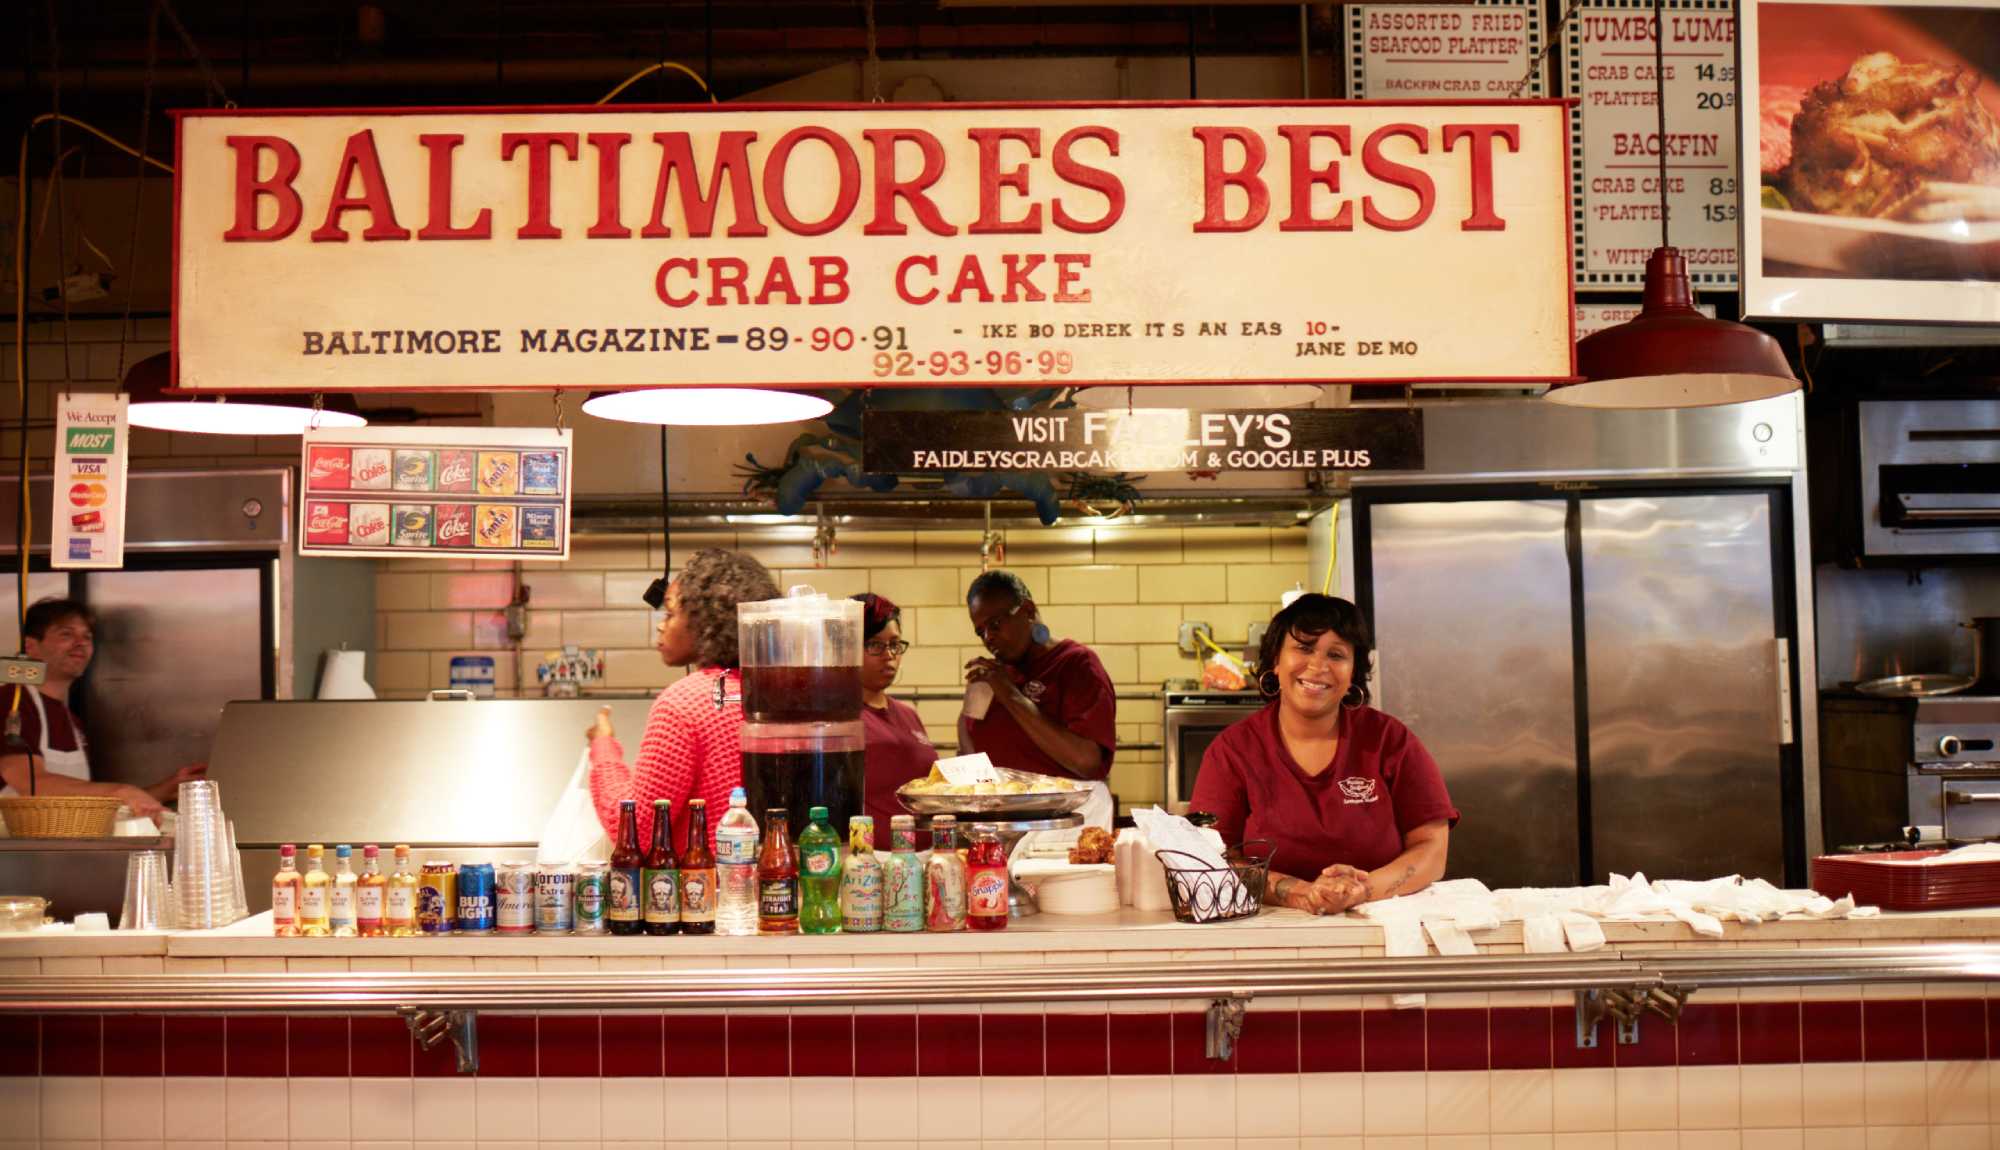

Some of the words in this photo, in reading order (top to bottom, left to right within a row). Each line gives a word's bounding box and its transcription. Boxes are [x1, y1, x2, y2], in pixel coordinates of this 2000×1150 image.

[1369, 13, 1461, 30] ASSORTED
[1472, 15, 1523, 31] FRIED
[1370, 37, 1441, 53] SEAFOOD
[1588, 66, 1628, 80] CRAB
[1386, 79, 1441, 91] BACKFIN
[1443, 79, 1481, 92] CRAB
[1613, 133, 1719, 156] BACKFIN
[224, 126, 1126, 243] BALTIMORES
[1192, 124, 1520, 233] BEST
[1592, 178, 1635, 193] CRAB
[655, 256, 850, 308] CRAB
[895, 254, 1093, 305] CAKE
[302, 329, 501, 355] BALTIMORE
[1029, 324, 1055, 338] BO
[1063, 323, 1132, 338] DEREK
[1198, 322, 1228, 337] AN
[1296, 341, 1346, 357] JANE
[84, 412, 117, 425] Accept
[1012, 416, 1069, 444] VISIT
[69, 433, 113, 449] MOST
[1207, 453, 1221, 468] &
[1227, 450, 1317, 468] GOOGLE
[1321, 449, 1371, 467] PLUS
[77, 464, 101, 473] VISA
[460, 896, 489, 908] BUD
[769, 905, 784, 914] TEA
[457, 906, 493, 919] LIGHT
